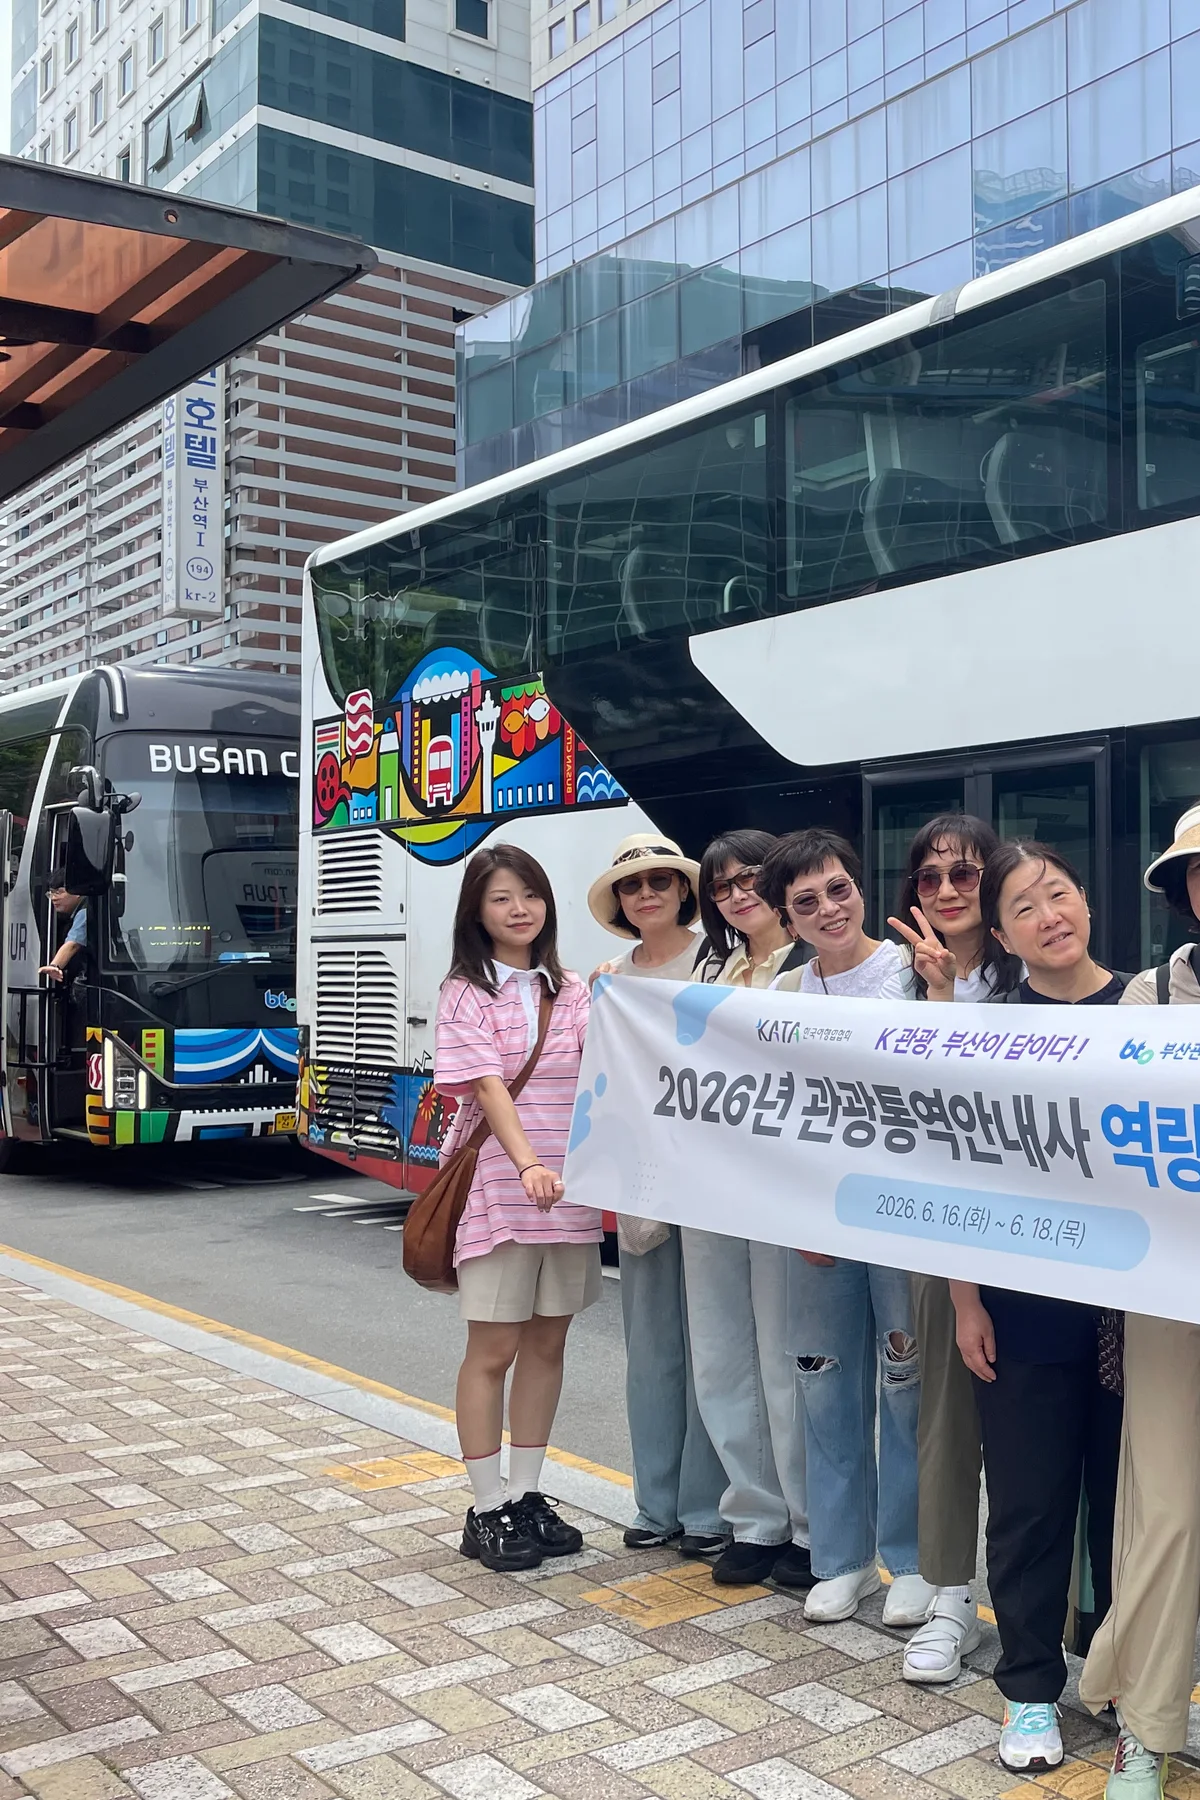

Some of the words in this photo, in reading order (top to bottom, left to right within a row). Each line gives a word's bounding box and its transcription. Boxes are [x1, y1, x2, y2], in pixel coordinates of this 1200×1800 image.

[189, 563, 210, 575] 194
[185, 588, 217, 604] kr-2
[148, 744, 269, 777] BUSAN
[8, 922, 28, 961] UR
[756, 1018, 801, 1044] KATA
[941, 1030, 1011, 1060] 부산이
[653, 1065, 795, 1138] 2026년
[797, 1076, 1094, 1180] 관광통역안내사
[875, 1193, 917, 1220] 2026.
[922, 1201, 935, 1223] 6.
[941, 1203, 991, 1235] 16.(화)
[1010, 1213, 1025, 1238] 6.
[1032, 1216, 1086, 1250] 18.(목)
